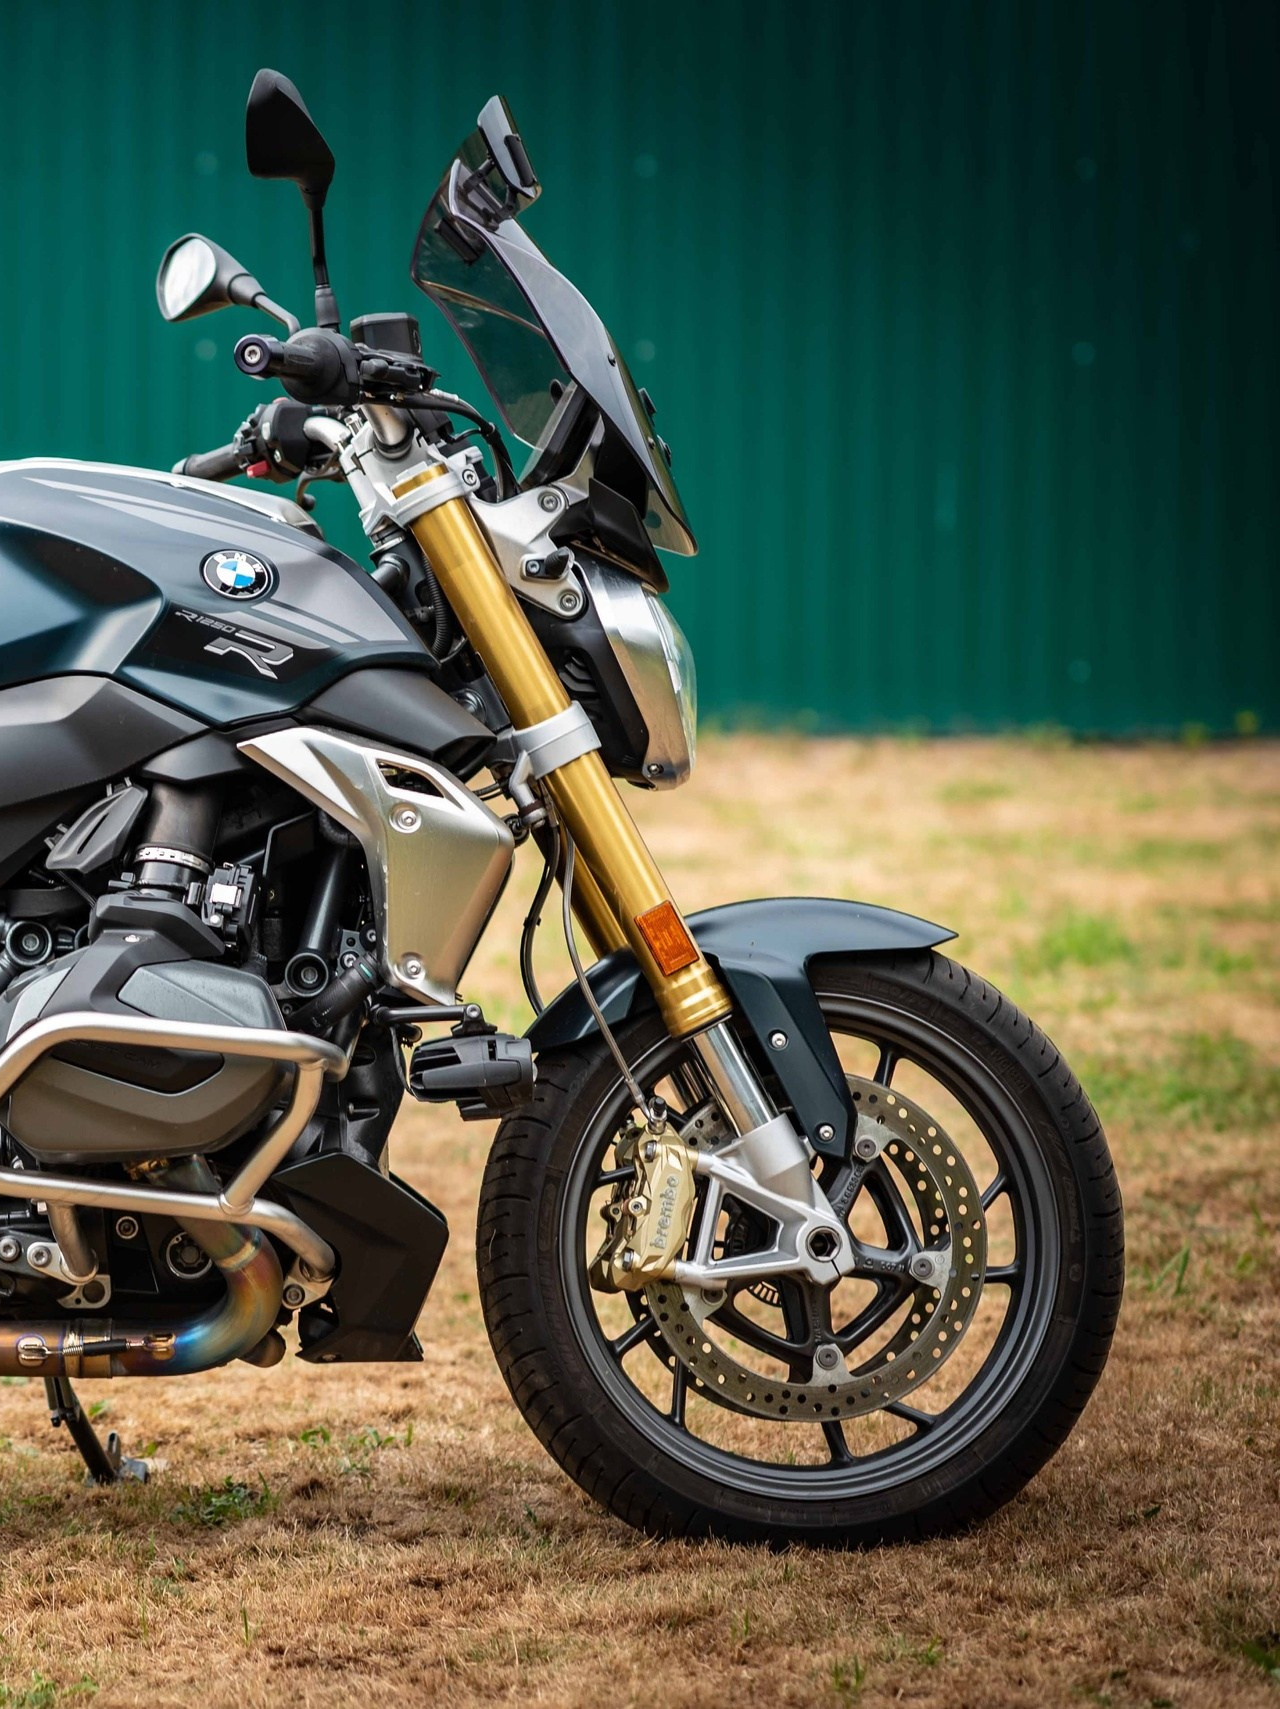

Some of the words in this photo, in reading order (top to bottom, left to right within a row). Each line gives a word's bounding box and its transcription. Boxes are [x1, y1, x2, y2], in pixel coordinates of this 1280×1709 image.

[213, 552, 264, 573] BMW
[203, 629, 294, 680] R
[649, 1175, 679, 1249] brembo
